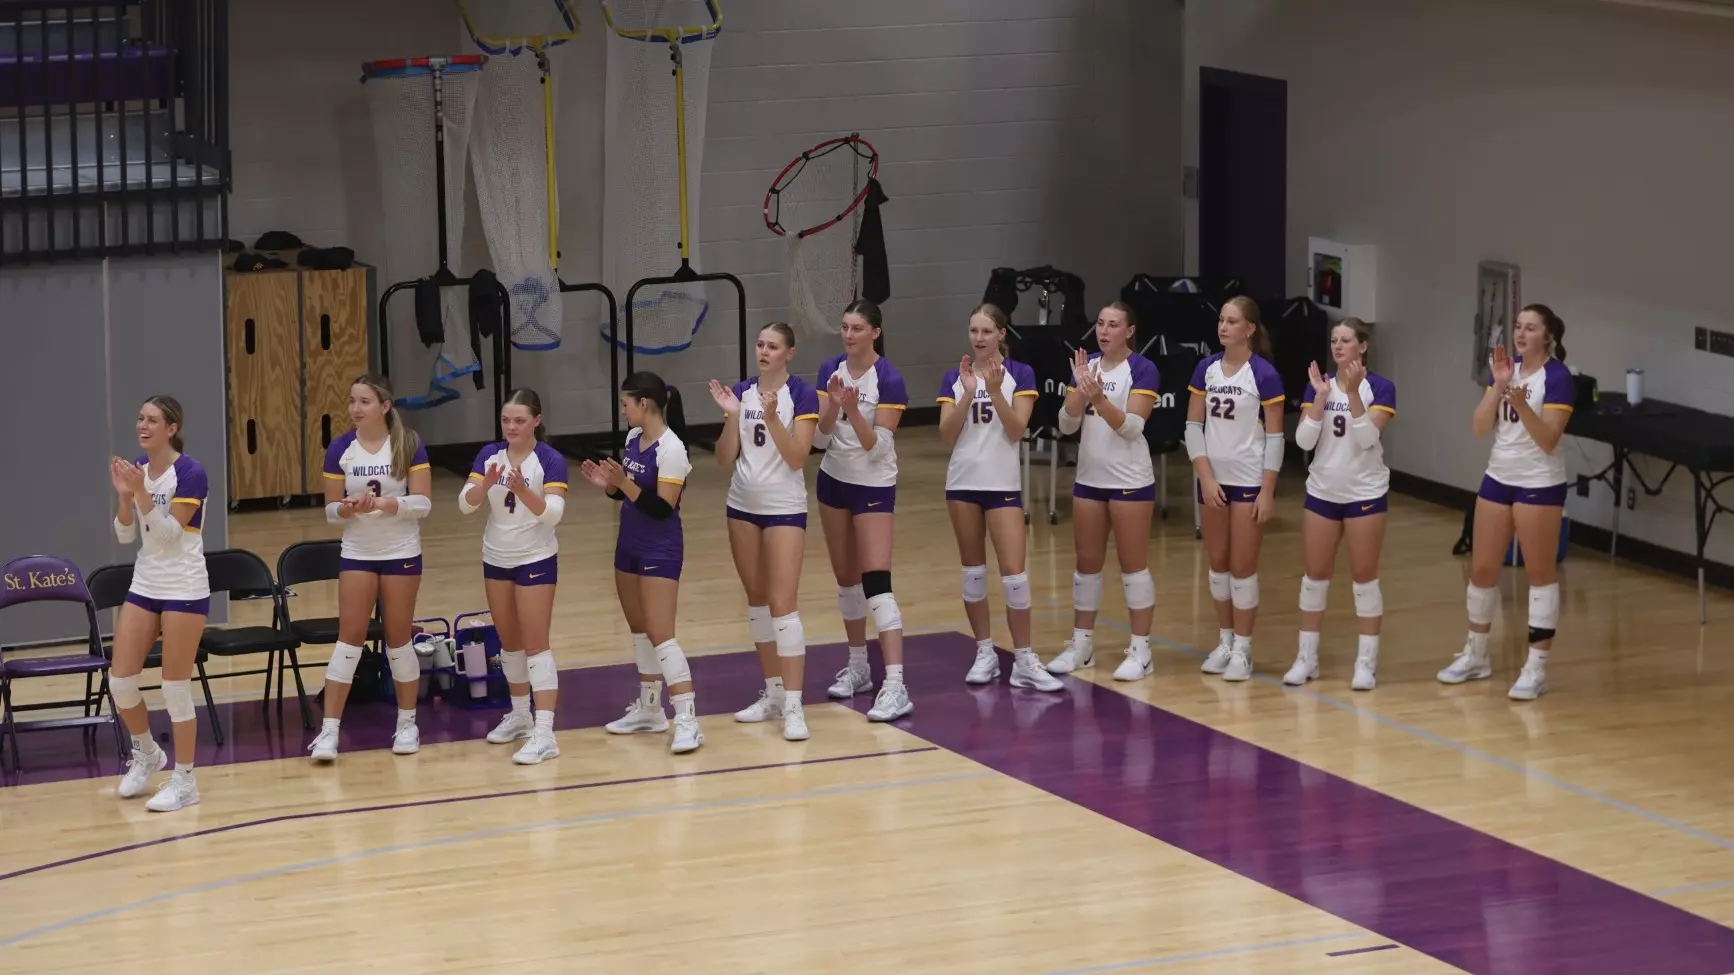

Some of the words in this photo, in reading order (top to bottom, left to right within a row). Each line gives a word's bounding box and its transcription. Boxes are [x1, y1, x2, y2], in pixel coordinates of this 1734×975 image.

[972, 401, 993, 424] 15
[1210, 396, 1235, 420] 22
[1324, 400, 1351, 412] WILDCA
[754, 423, 766, 447] 6
[1333, 414, 1346, 438] 9
[352, 464, 392, 477] WILDCAT
[366, 479, 382, 498] 3
[504, 490, 516, 514] 4
[4, 573, 26, 591] St.
[28, 567, 76, 589] Kate's
